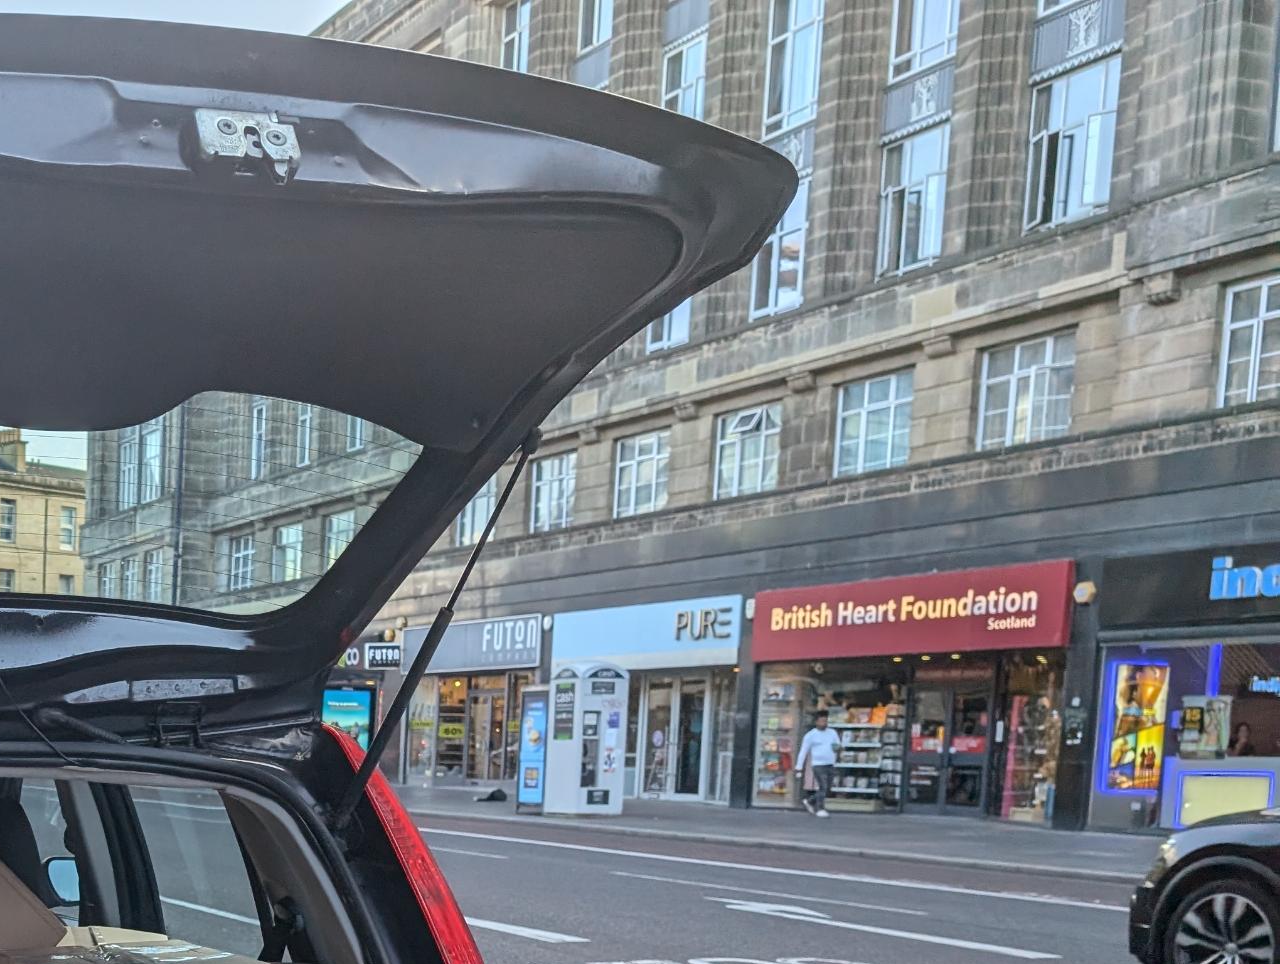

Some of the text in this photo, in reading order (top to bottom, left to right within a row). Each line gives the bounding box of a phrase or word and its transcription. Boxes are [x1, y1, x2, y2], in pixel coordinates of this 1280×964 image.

[675, 607, 732, 641] PURE
[770, 586, 1038, 632] British Heart Foundation
[986, 614, 1037, 632] Scotland
[482, 618, 537, 652] FUTON
[369, 648, 400, 661] FUTON
